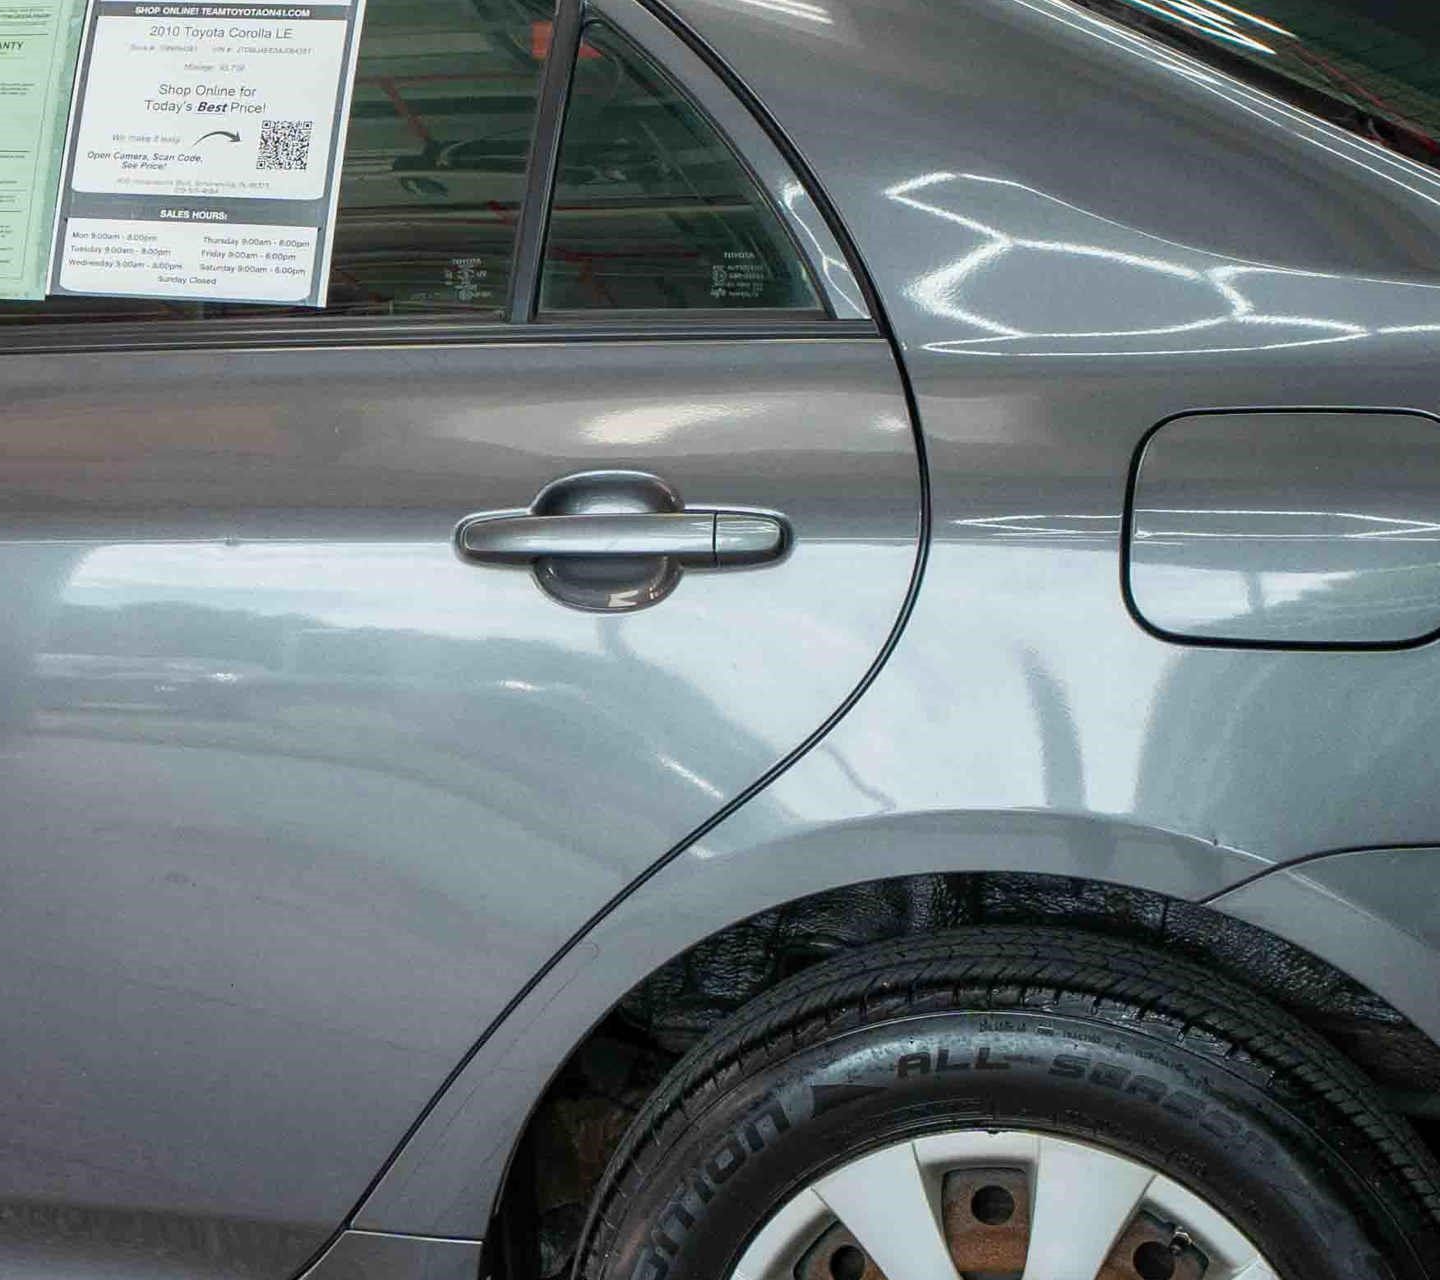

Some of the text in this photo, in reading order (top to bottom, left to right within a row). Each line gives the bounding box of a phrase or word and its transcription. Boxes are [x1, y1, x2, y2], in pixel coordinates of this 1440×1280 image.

[135, 6, 161, 15] SHOP
[162, 7, 199, 16] ONLINE!
[149, 25, 293, 40] 2010 Toyota Corolla LE
[158, 84, 257, 99] Shop Online for
[143, 100, 267, 114] Today's Best Price!
[87, 151, 111, 162] Open
[152, 153, 175, 162] Scan
[121, 161, 138, 169] See
[160, 209, 227, 220] SALES HOURS:
[203, 236, 239, 246] Thursday
[71, 245, 101, 254] Tuesday
[201, 250, 226, 259] Friday
[157, 275, 217, 285] Sunday Closed
[896, 1046, 1012, 1080] ALL
